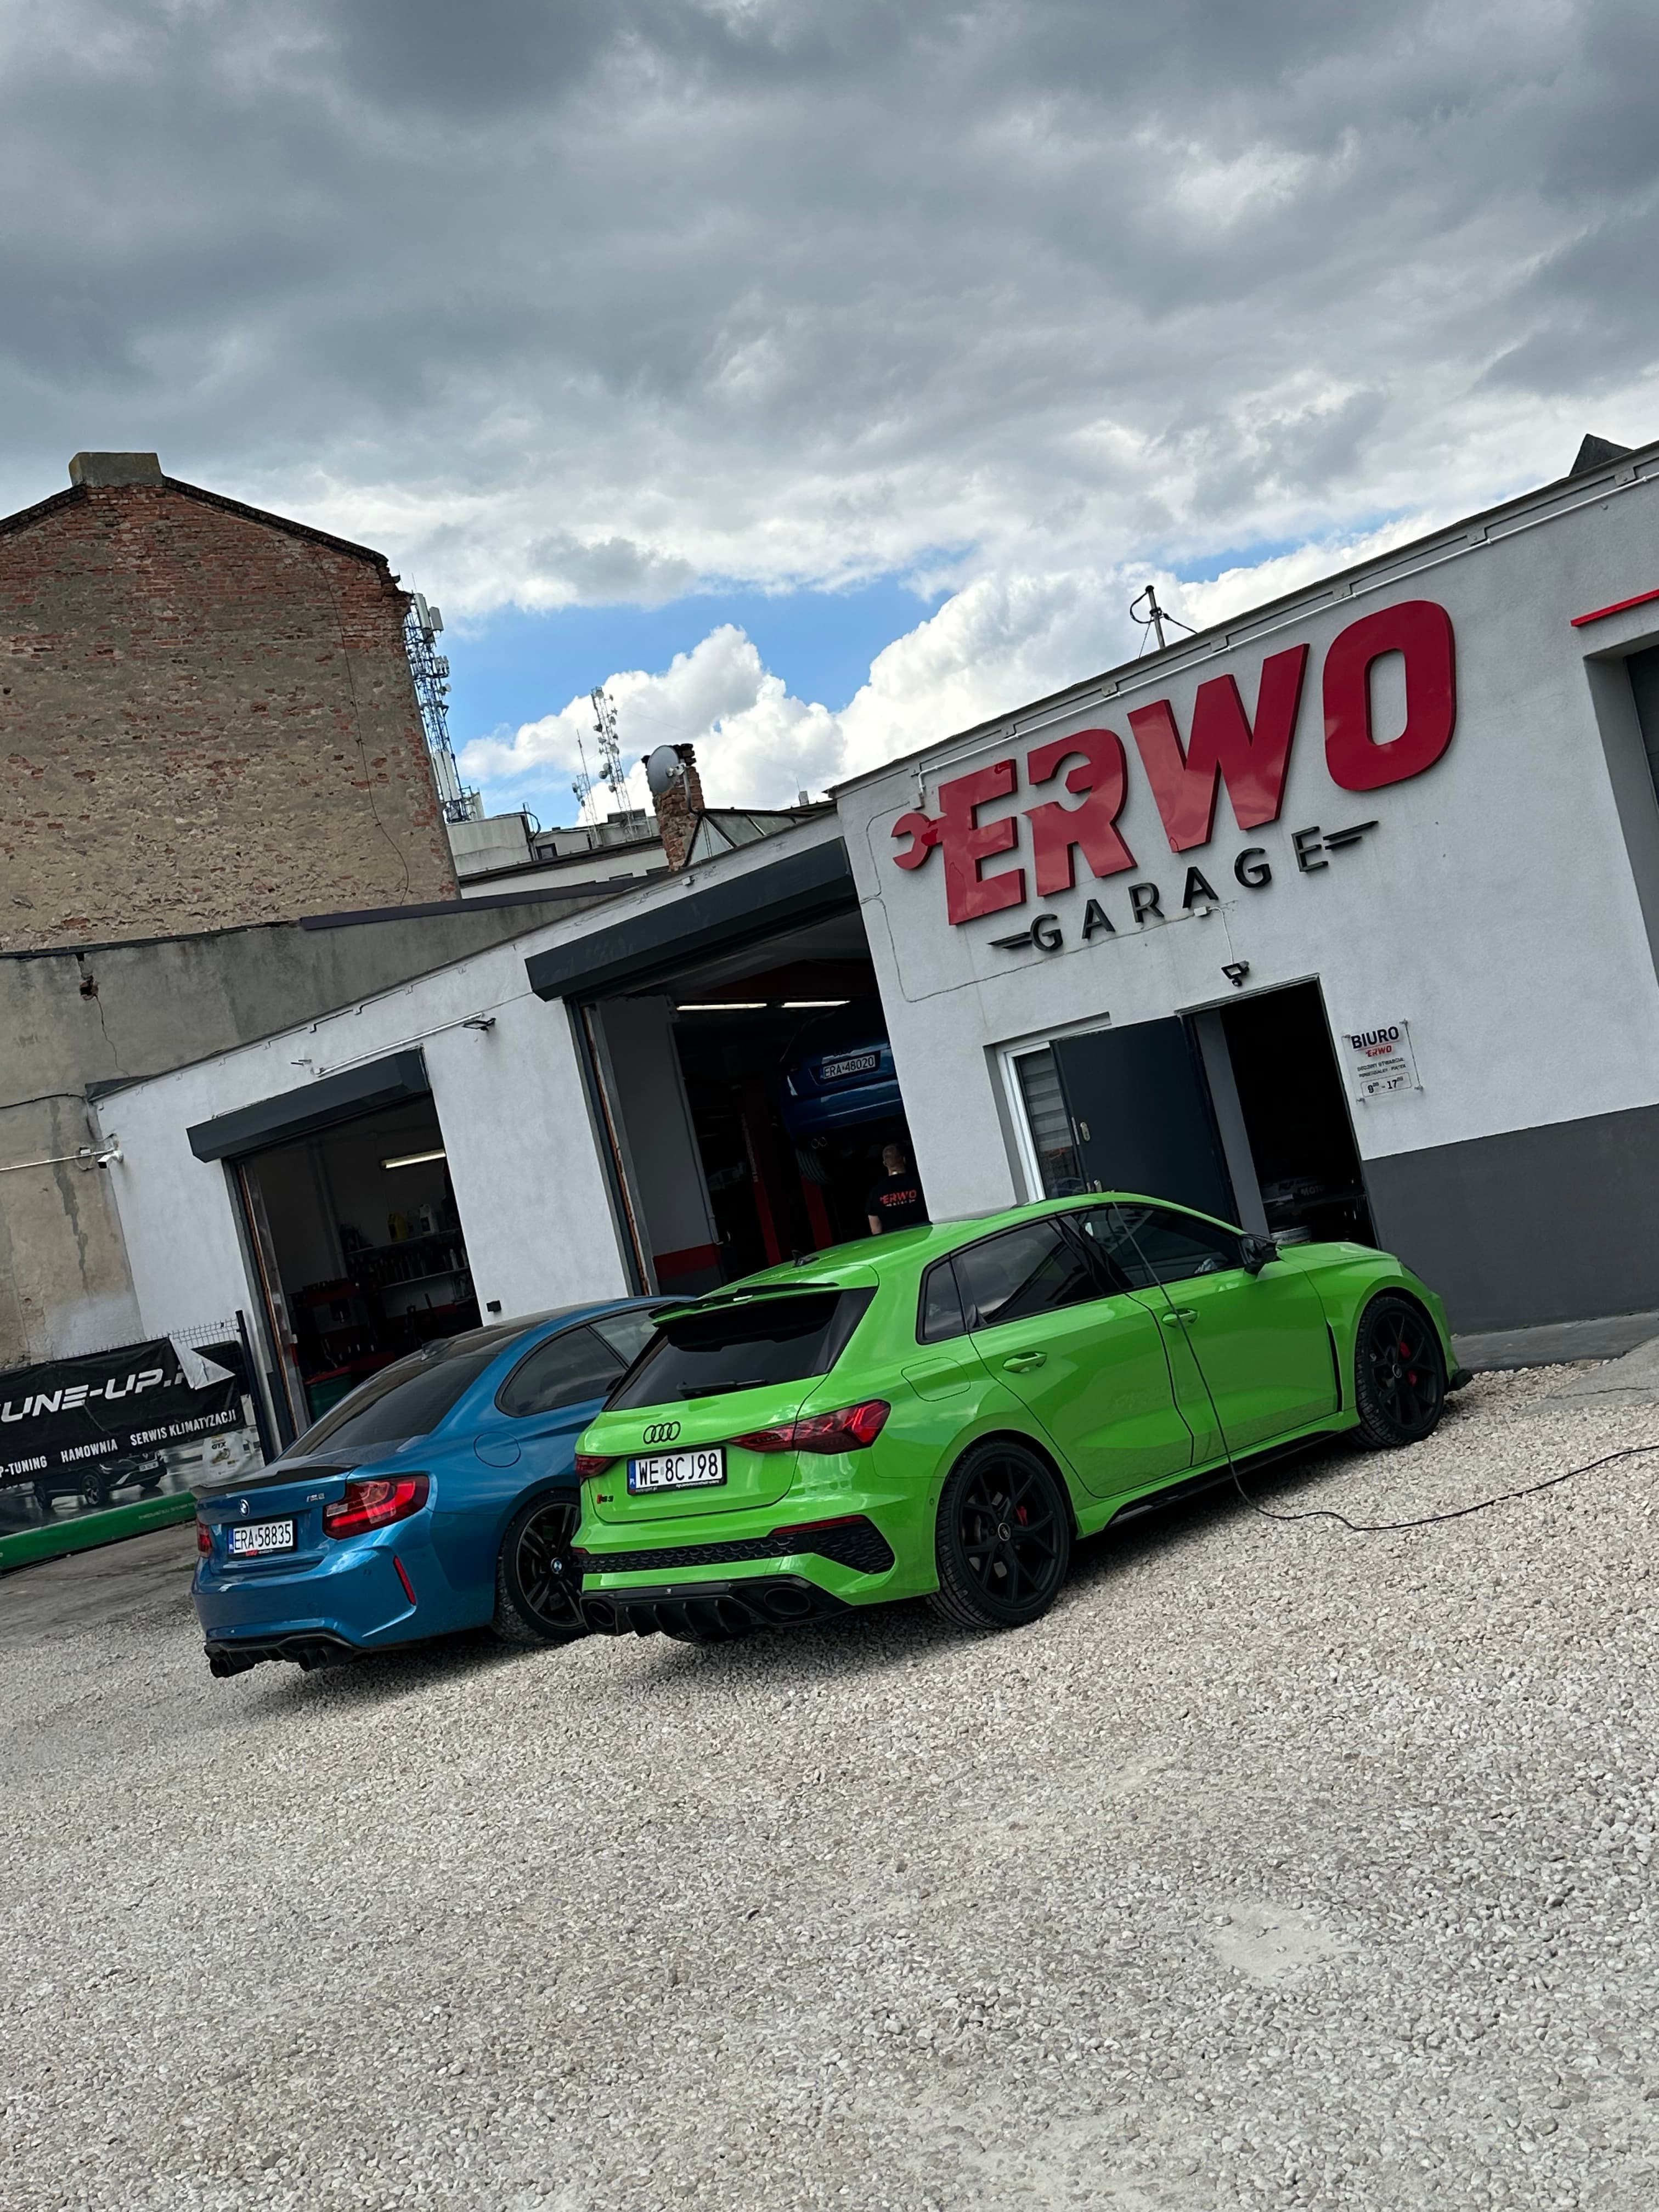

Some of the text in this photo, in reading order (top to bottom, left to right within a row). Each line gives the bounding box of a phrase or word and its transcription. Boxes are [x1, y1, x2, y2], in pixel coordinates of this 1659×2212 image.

[939, 600, 1457, 926] ERWO
[1029, 825, 1329, 952] GARAGE
[1351, 1026, 1400, 1049] BIURO
[1367, 1045, 1392, 1058] ERWO
[824, 1056, 874, 1077] ERA 48020
[880, 1188, 918, 1205] ERWO
[0, 1364, 185, 1423] UNE-UP.
[60, 1438, 118, 1463] HAMOWNIA
[129, 1427, 167, 1446] SERWIS
[168, 1409, 236, 1437] KLIMATYZACJI
[211, 1441, 227, 1449] GTX
[639, 1452, 718, 1486] WE 8CJ98
[234, 1523, 291, 1550] ERA 58835
